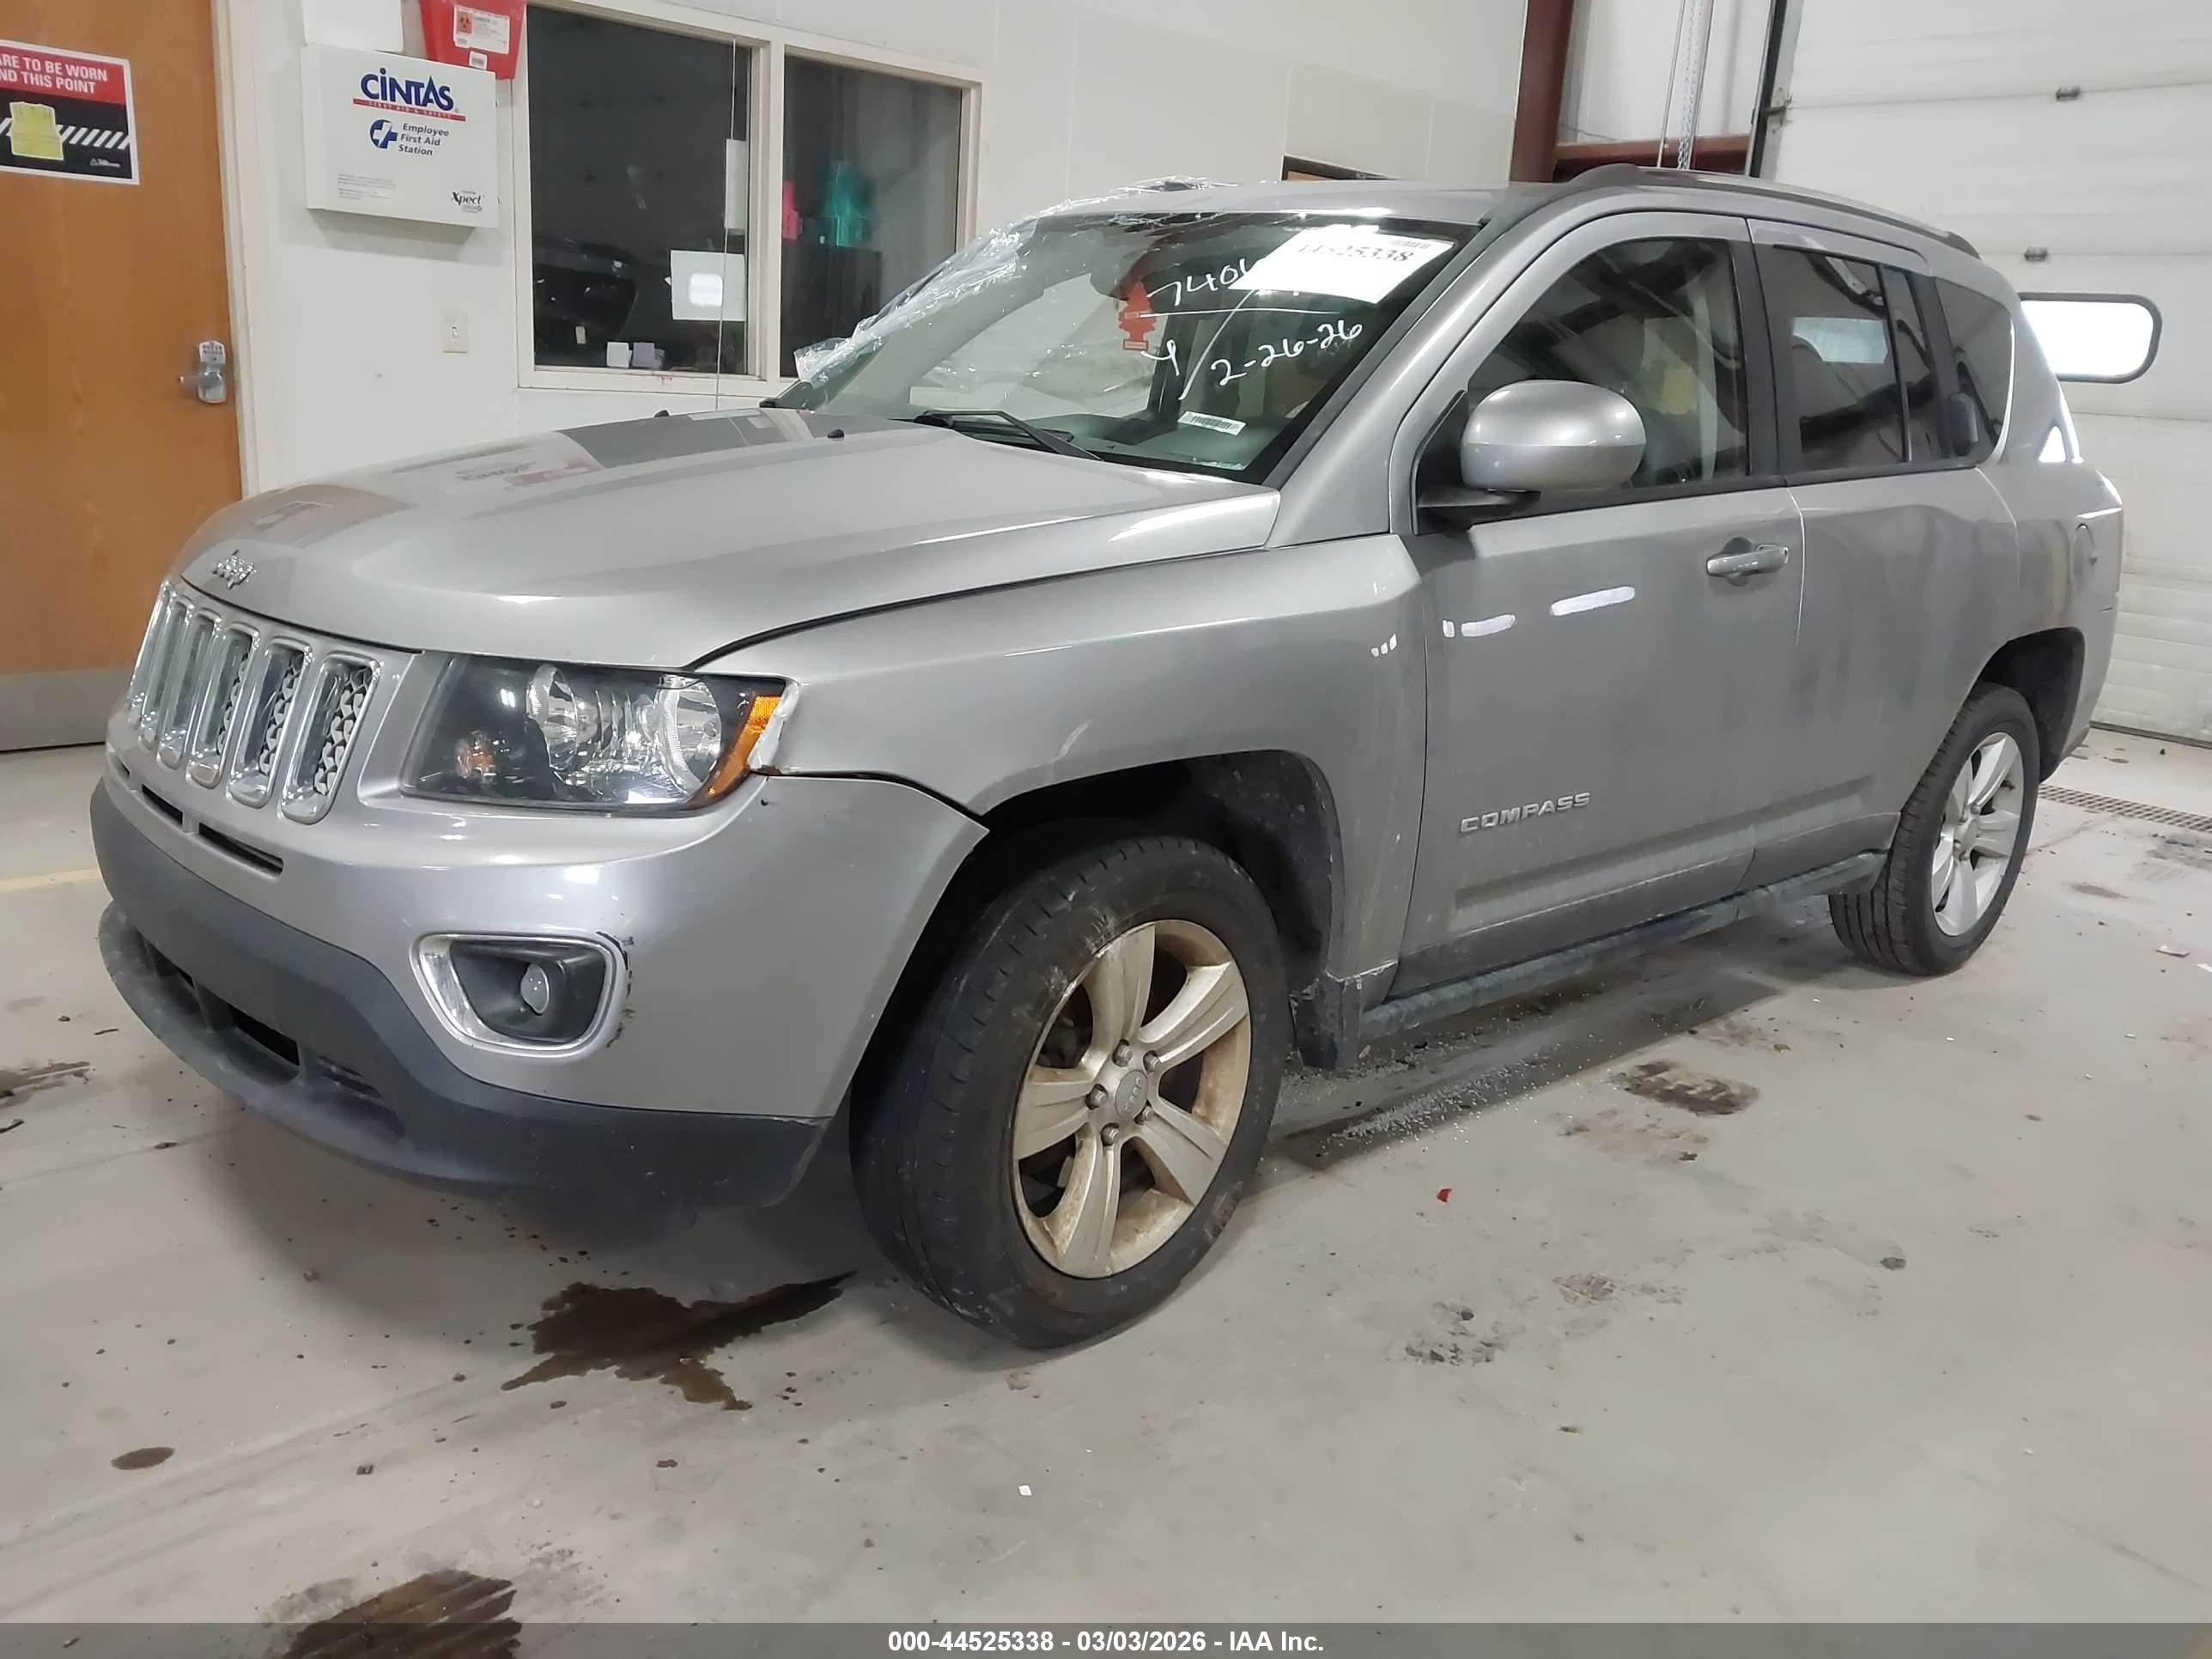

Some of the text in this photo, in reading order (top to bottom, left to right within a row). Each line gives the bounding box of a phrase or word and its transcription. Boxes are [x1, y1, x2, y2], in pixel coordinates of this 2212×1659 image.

[22, 57, 41, 71] TO
[45, 60, 63, 76] BE
[65, 64, 108, 82] WORN
[21, 71, 52, 88] THIS
[56, 76, 96, 94] POINT
[400, 133, 441, 146] First Aid
[403, 123, 450, 137] Employee
[398, 144, 433, 155] Station
[1211, 320, 1363, 386] 2-26-26
[1460, 792, 1591, 833] COMPASS
